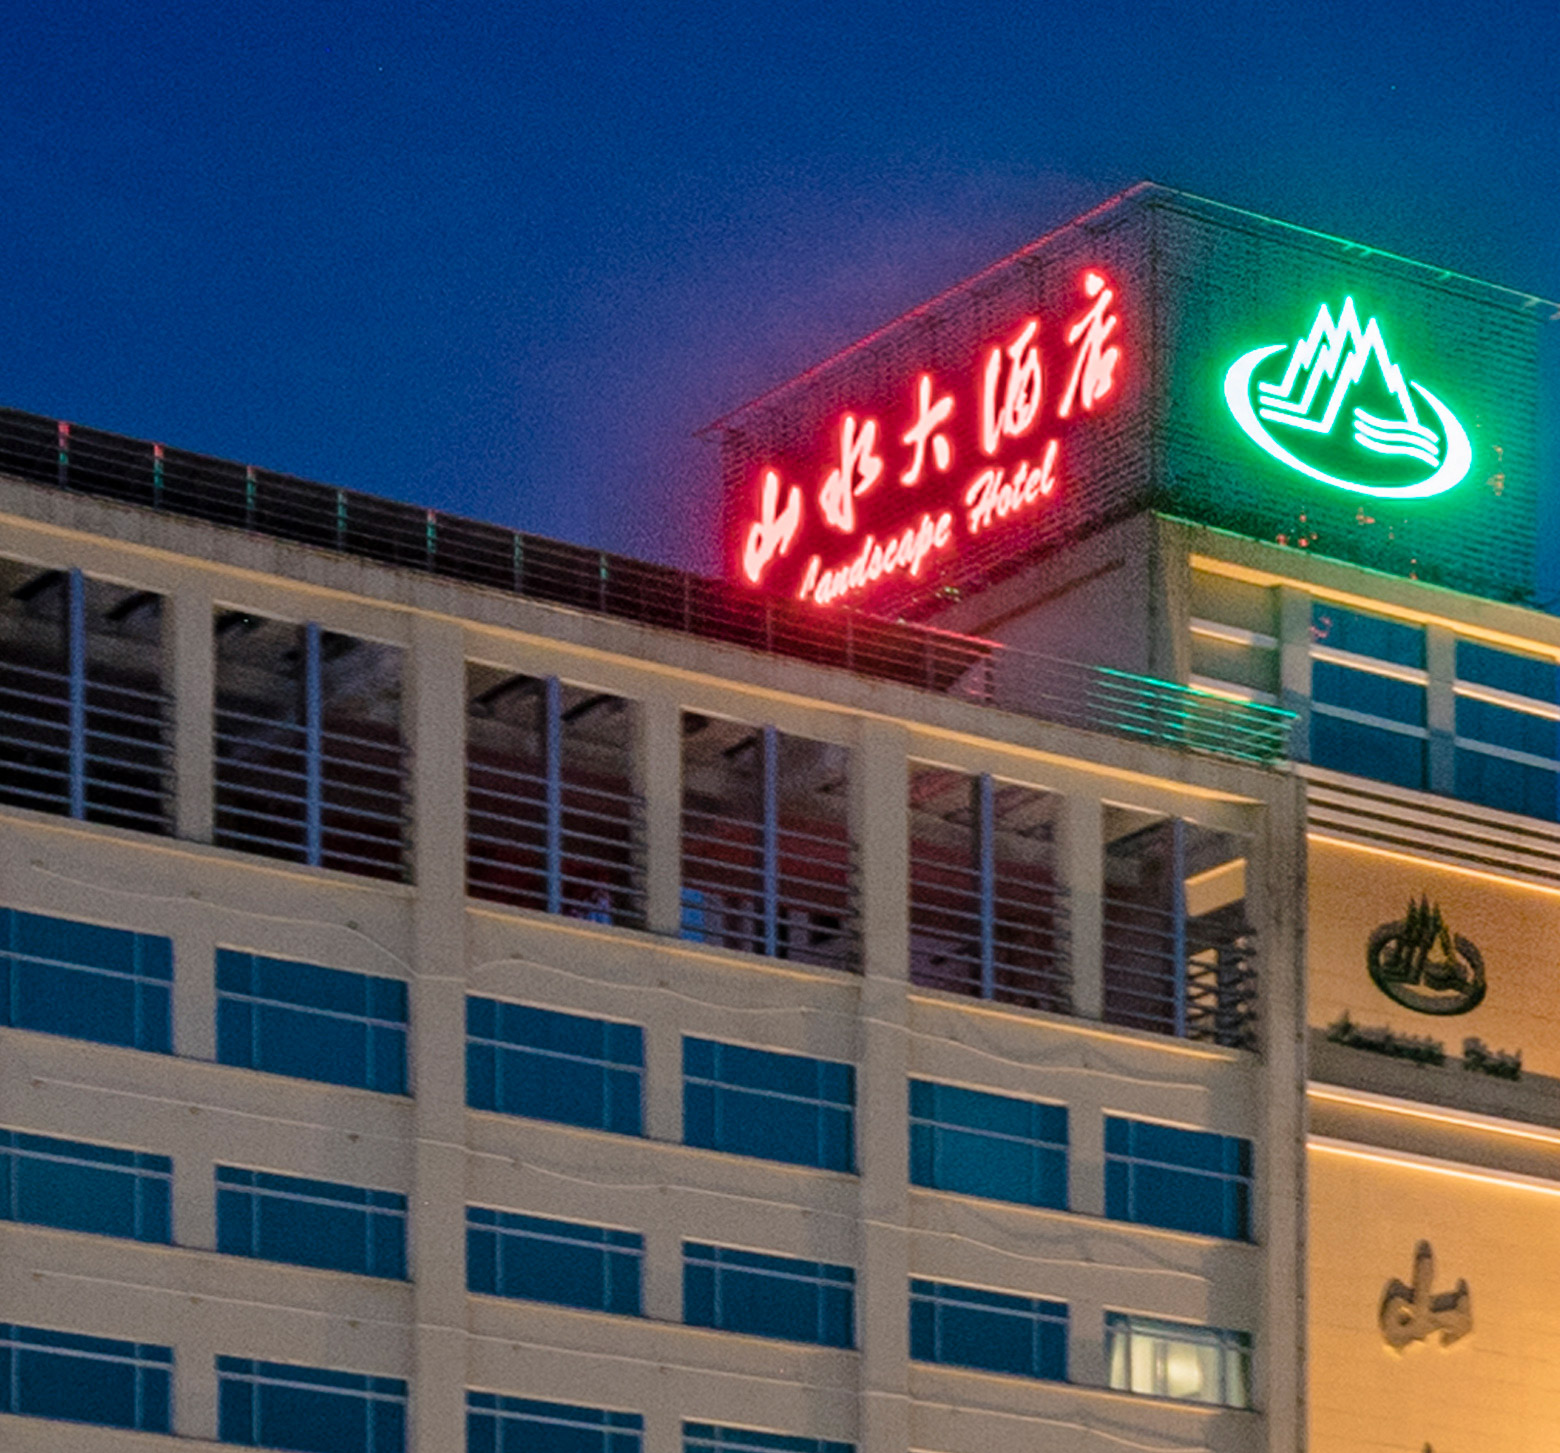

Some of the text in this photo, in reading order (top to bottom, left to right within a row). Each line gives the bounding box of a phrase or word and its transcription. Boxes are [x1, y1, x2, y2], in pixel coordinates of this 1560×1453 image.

[743, 272, 1120, 583] 山水大酒店
[800, 439, 1059, 605] Landscape Hotel
